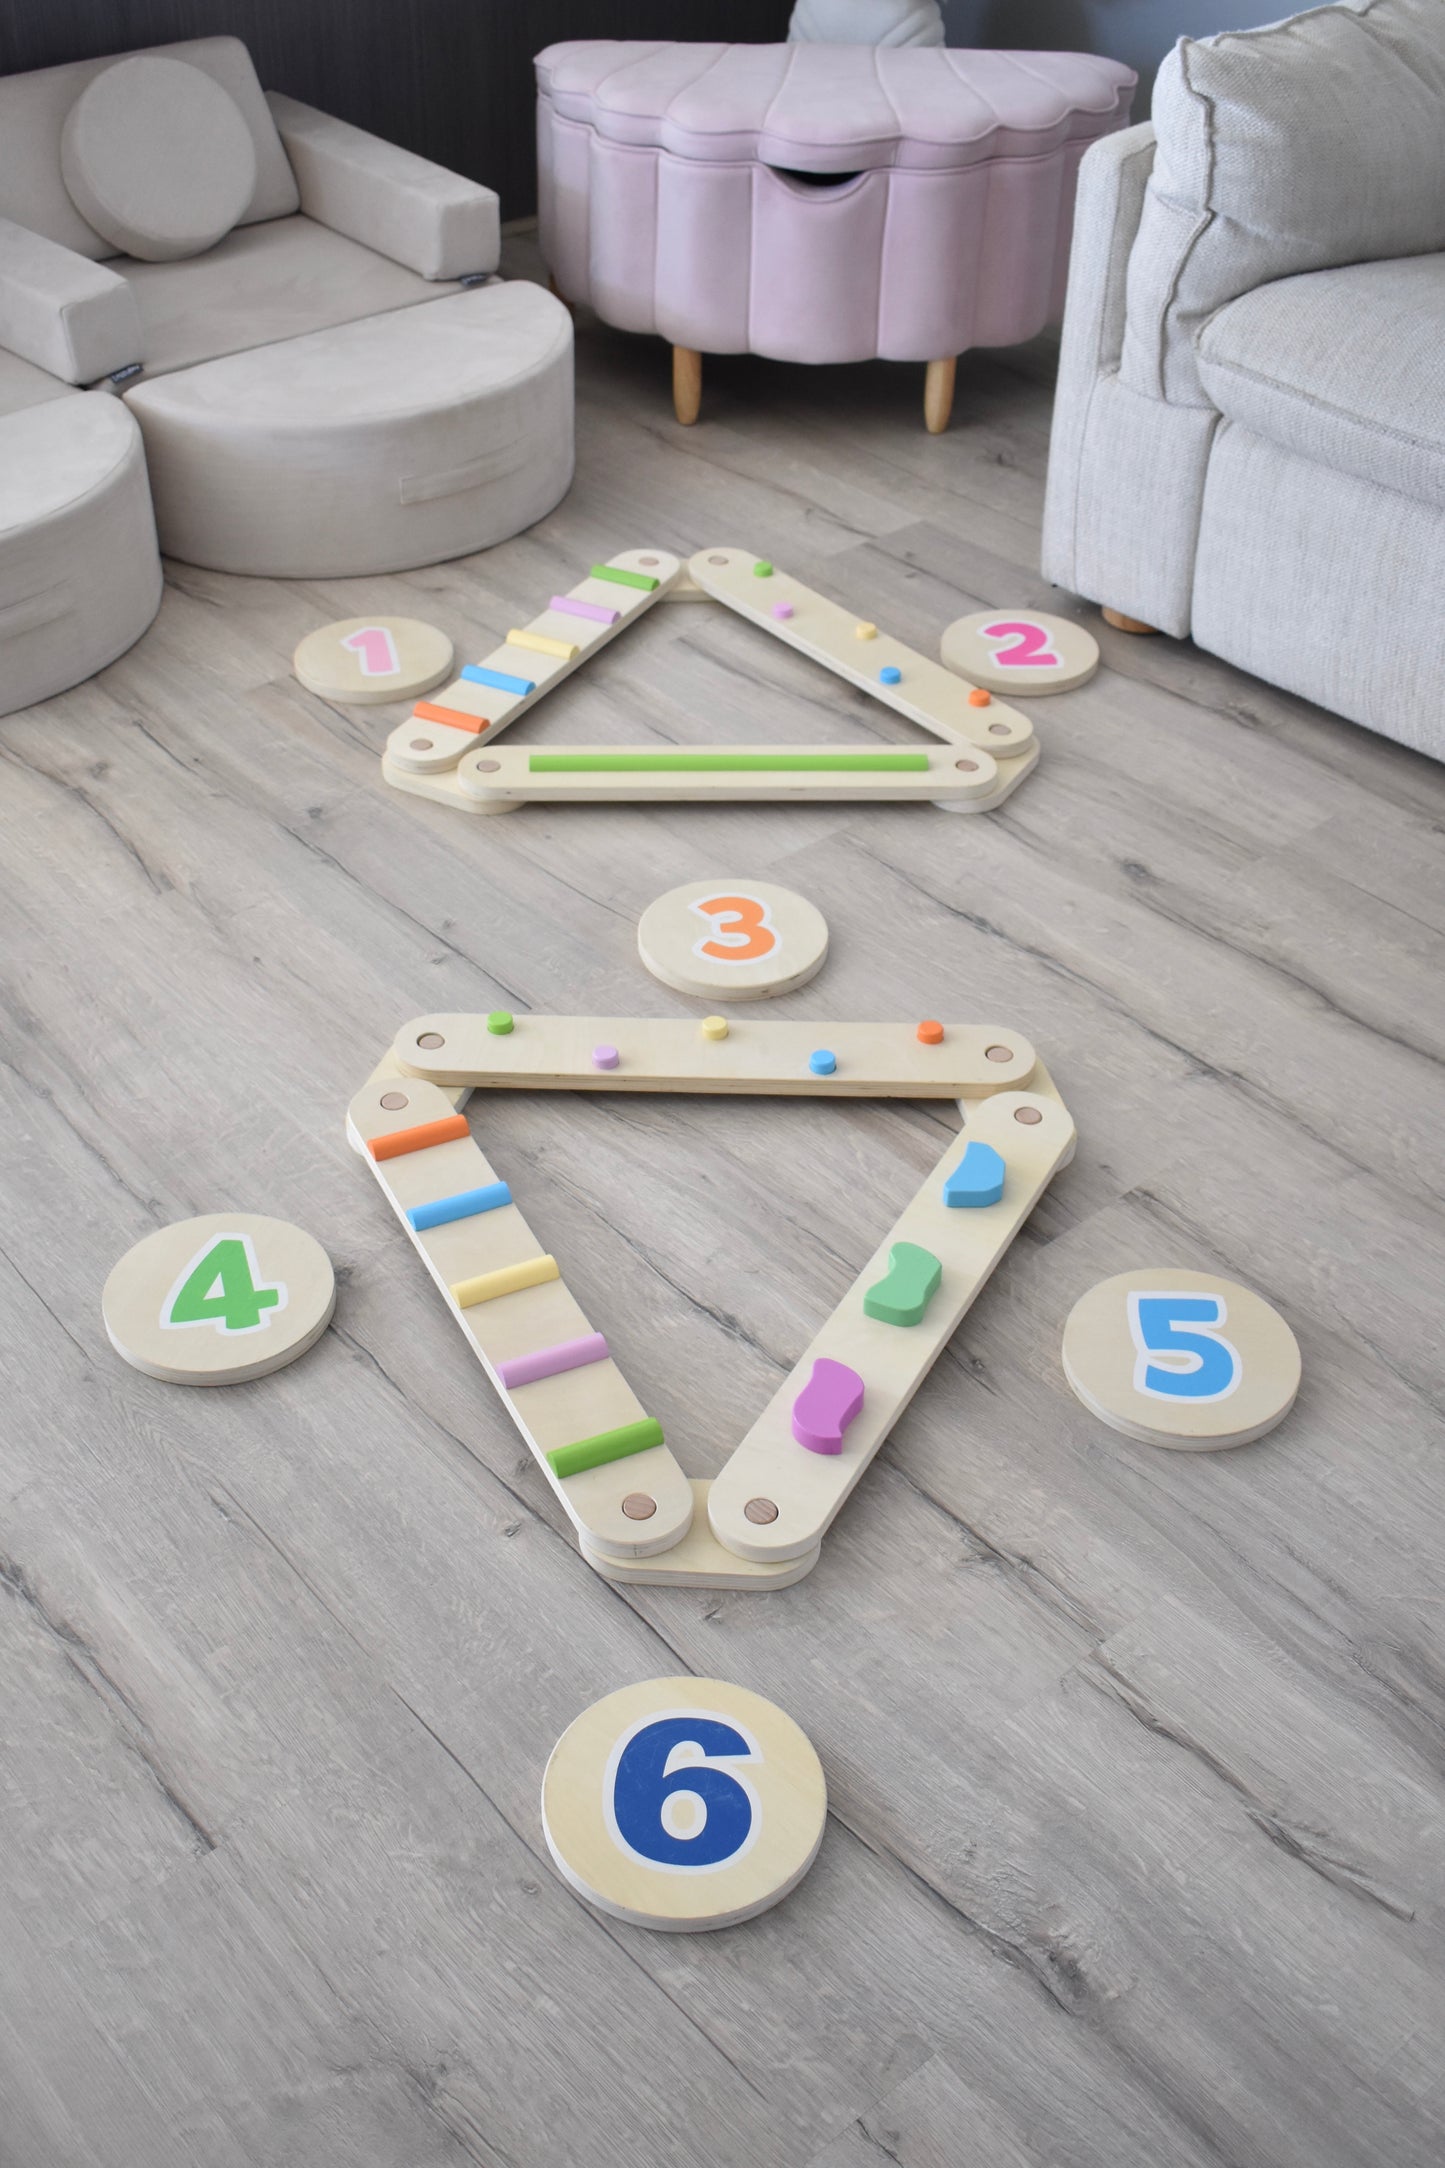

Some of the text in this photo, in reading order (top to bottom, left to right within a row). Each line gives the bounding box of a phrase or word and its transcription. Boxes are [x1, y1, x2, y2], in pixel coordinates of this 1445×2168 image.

[349, 630, 393, 672] 1
[983, 622, 1058, 665] 2
[698, 897, 775, 960] 3
[170, 1240, 278, 1329] 4
[1138, 1298, 1234, 1397] 5
[613, 1717, 752, 1867] 6
